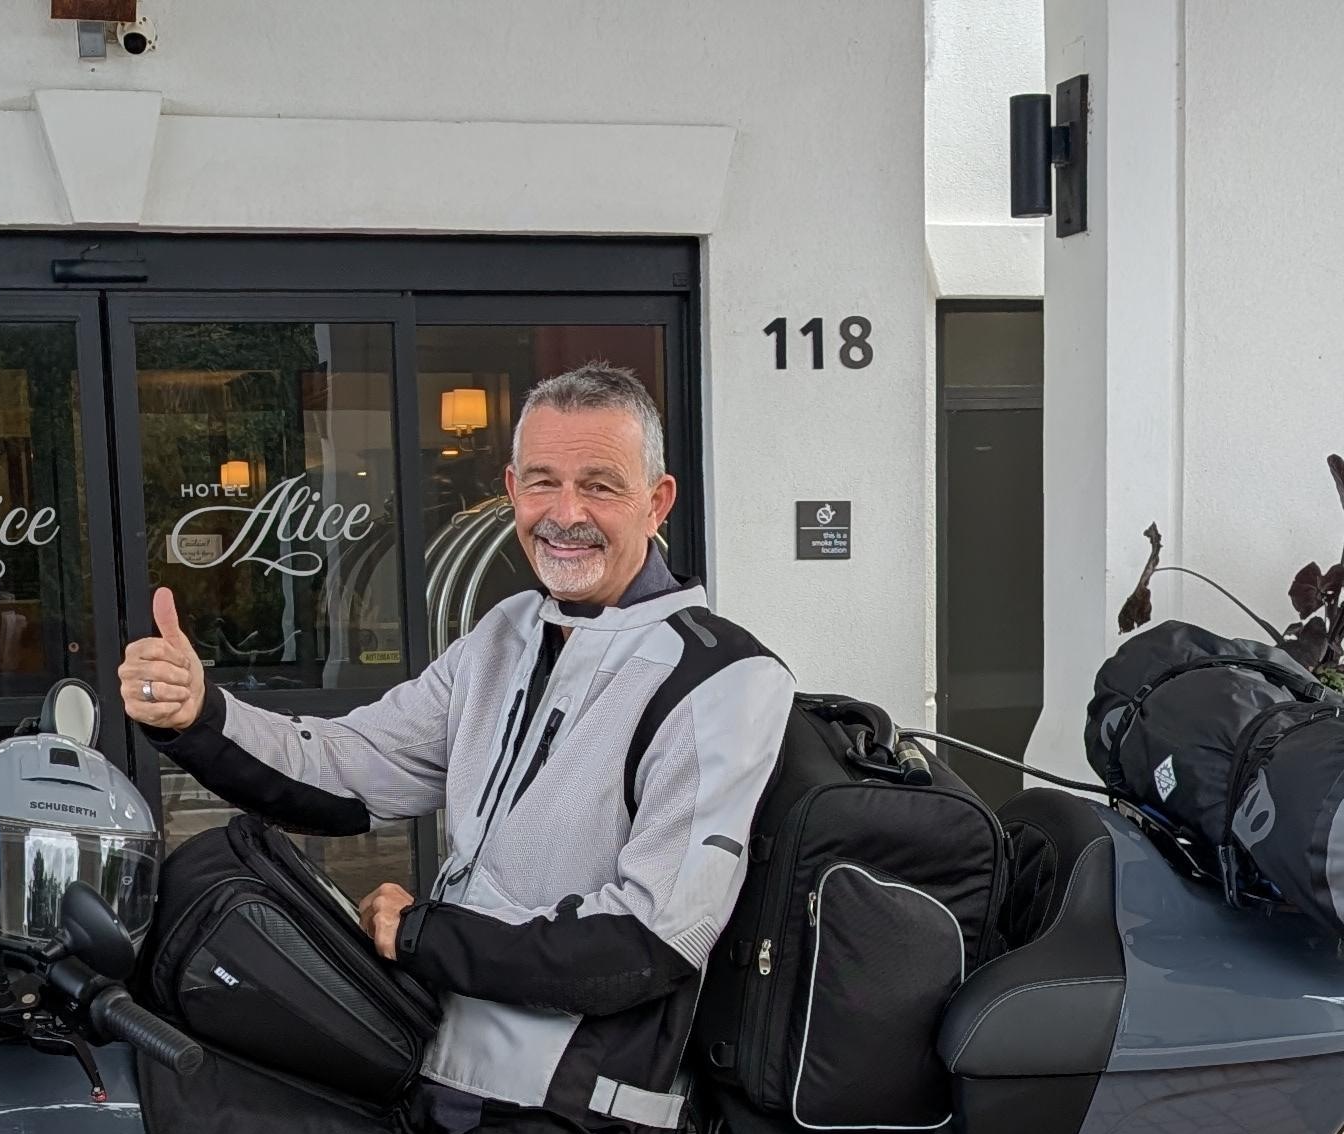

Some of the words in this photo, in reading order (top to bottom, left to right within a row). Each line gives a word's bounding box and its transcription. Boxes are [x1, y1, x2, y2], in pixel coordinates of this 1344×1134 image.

[763, 316, 873, 369] 118
[181, 484, 248, 497] HOTEL
[171, 472, 374, 576] Alice
[30, 801, 97, 818] SCHUBERTH
[214, 966, 239, 986] BILT
